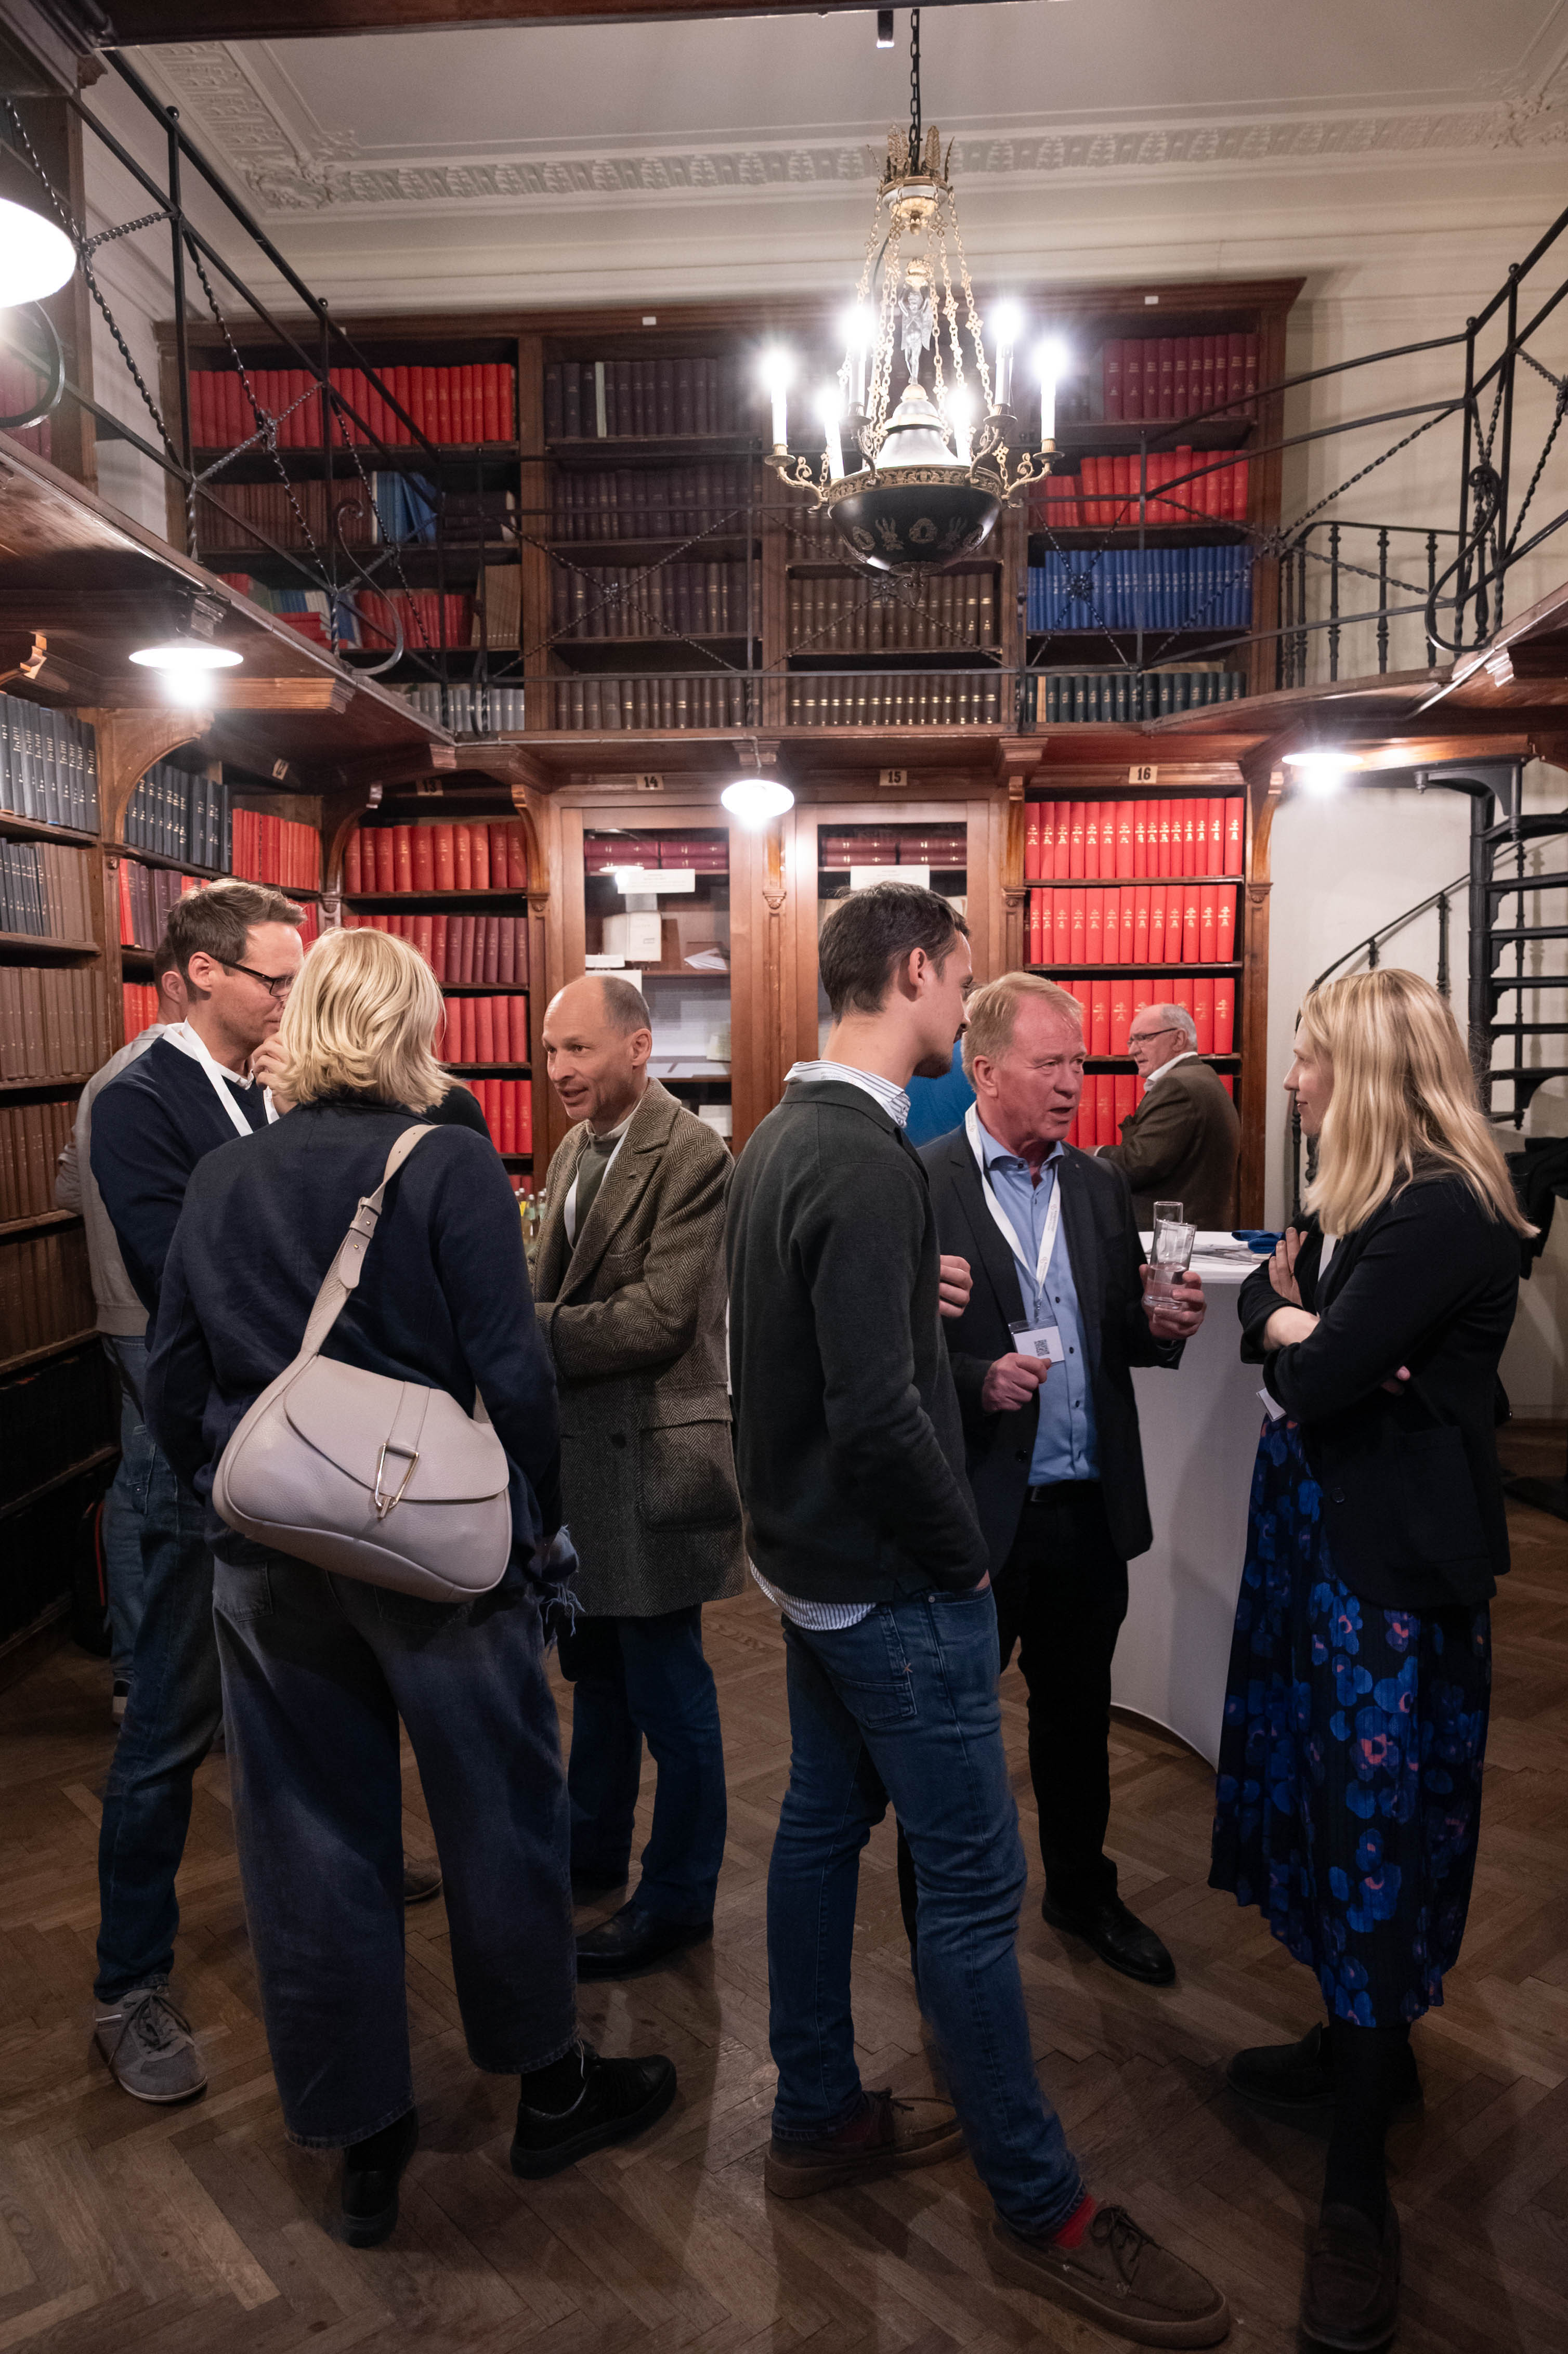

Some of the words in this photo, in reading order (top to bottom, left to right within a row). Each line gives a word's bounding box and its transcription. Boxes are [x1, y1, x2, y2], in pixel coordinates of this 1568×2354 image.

[888, 771, 901, 783] 15
[1138, 767, 1151, 780] 16
[422, 778, 437, 792] 13
[644, 776, 658, 788] 14
